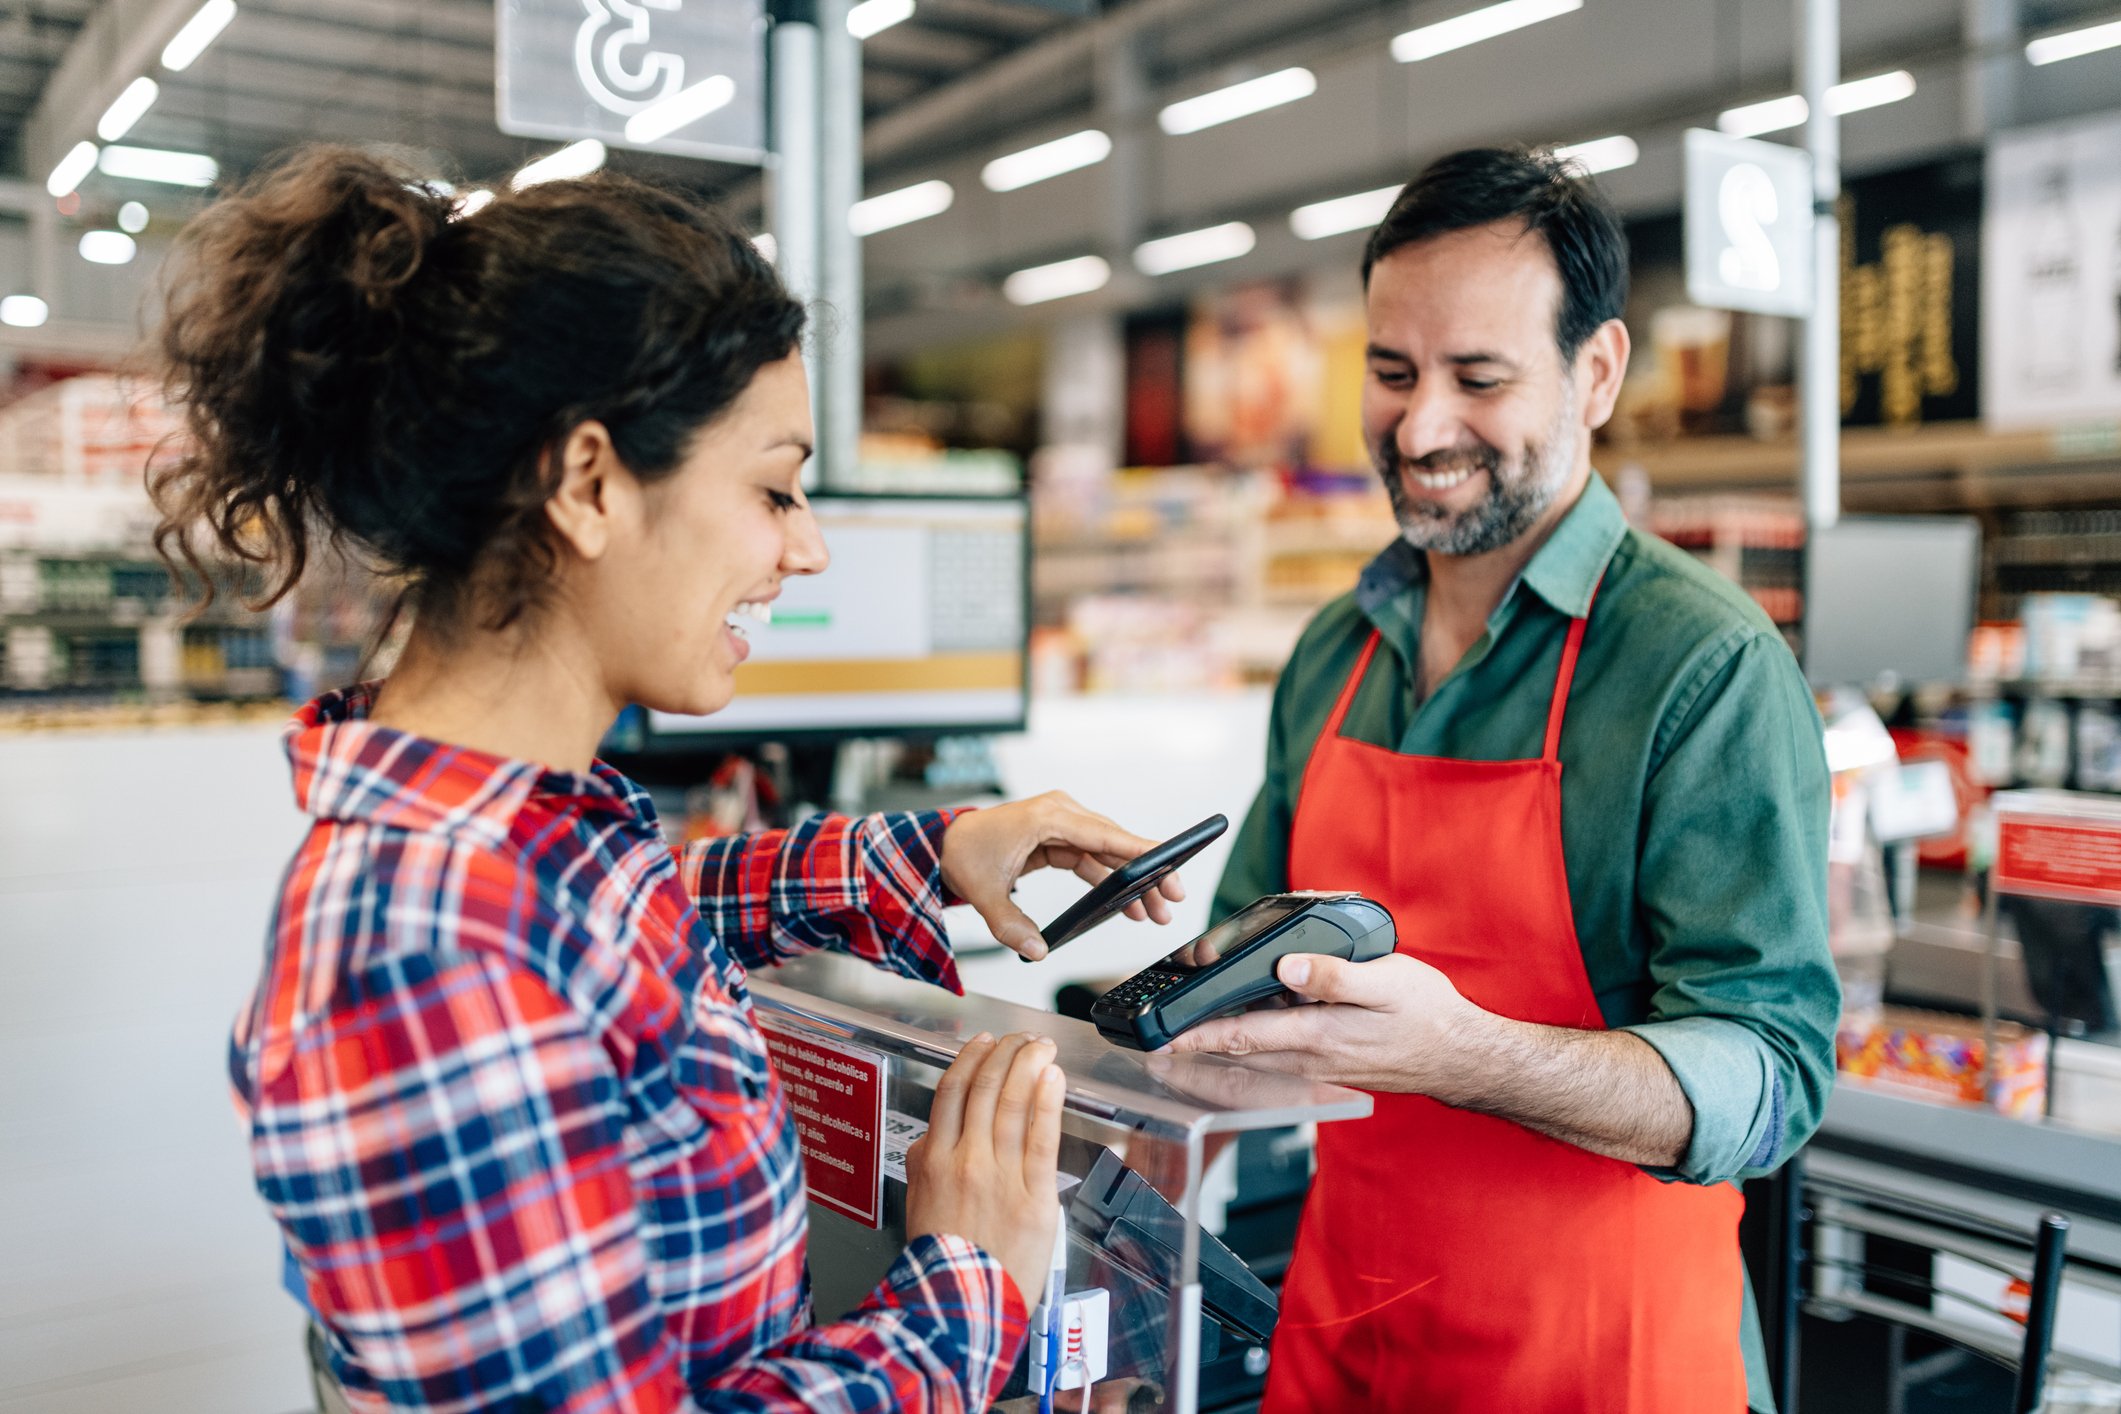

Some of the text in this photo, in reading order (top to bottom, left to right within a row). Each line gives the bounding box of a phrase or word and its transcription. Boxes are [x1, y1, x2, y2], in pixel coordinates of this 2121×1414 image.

[782, 1059, 803, 1079] horas,
[804, 1068, 813, 1082] de
[815, 1074, 844, 1093] acuerdo
[845, 1084, 853, 1096] al
[788, 1044, 796, 1057] de
[797, 1046, 825, 1067] bebidas
[826, 1058, 868, 1082] alcohólicas
[793, 1101, 820, 1122] bebidas
[821, 1113, 863, 1139] alcohólicas
[864, 1131, 870, 1142] a
[807, 1127, 826, 1144] años.
[809, 1147, 854, 1175] ocasionadas
